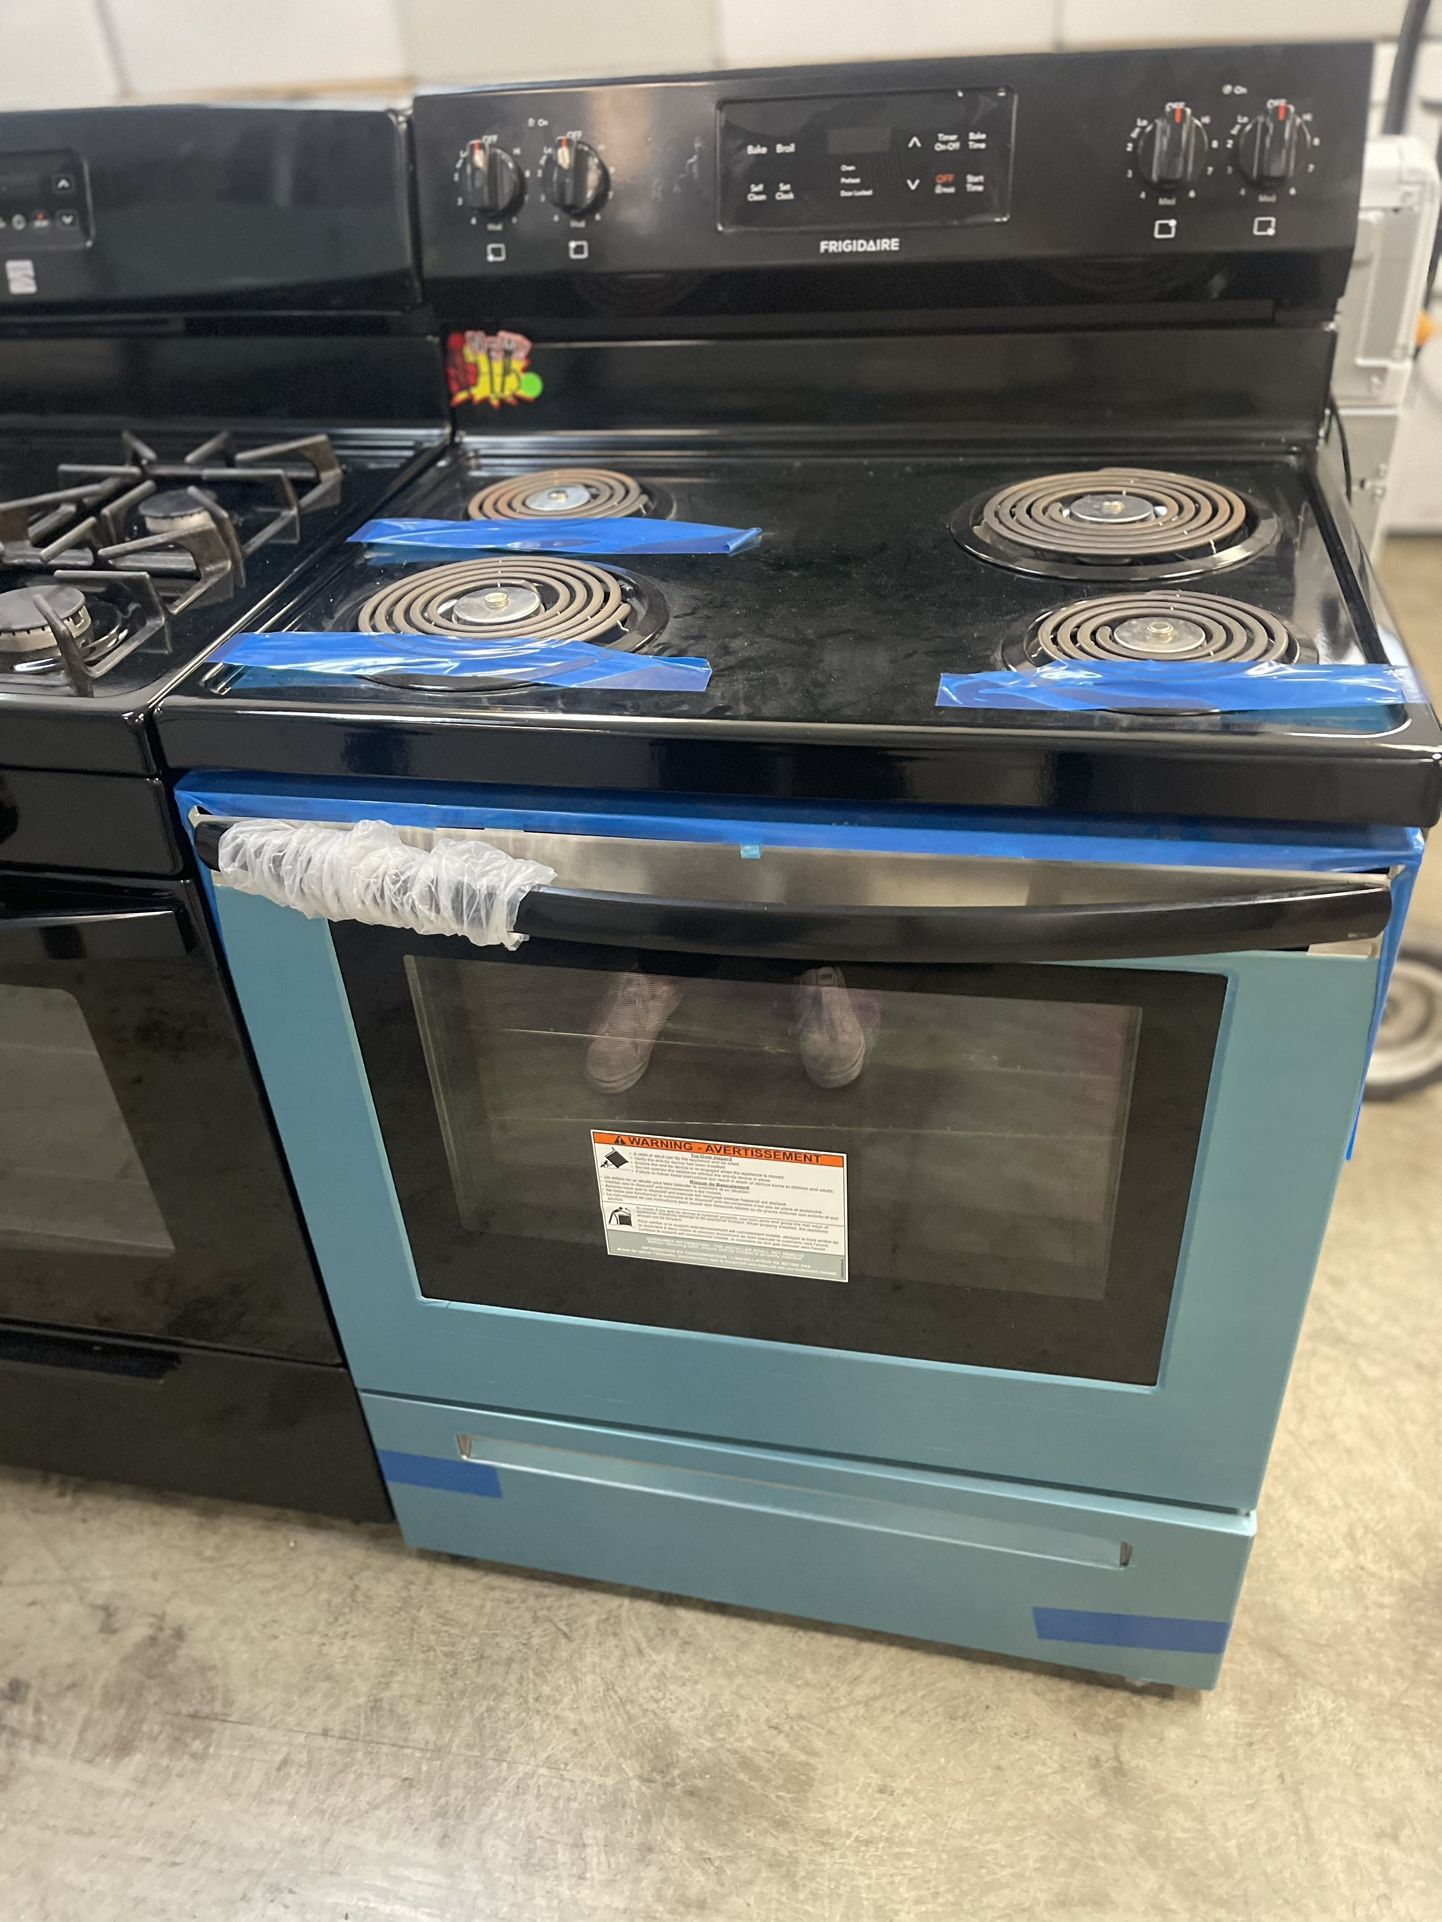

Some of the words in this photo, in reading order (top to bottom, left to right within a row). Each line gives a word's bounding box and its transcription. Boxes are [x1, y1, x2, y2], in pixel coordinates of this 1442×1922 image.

[968, 131, 987, 140] Bake
[747, 145, 768, 155] Bake
[776, 143, 795, 154] Broil
[935, 174, 955, 184] OFF
[819, 238, 900, 253] FRIGIDAIRE
[628, 1137, 693, 1151] WARNING
[705, 1144, 822, 1164] AVERTISSEMENT
